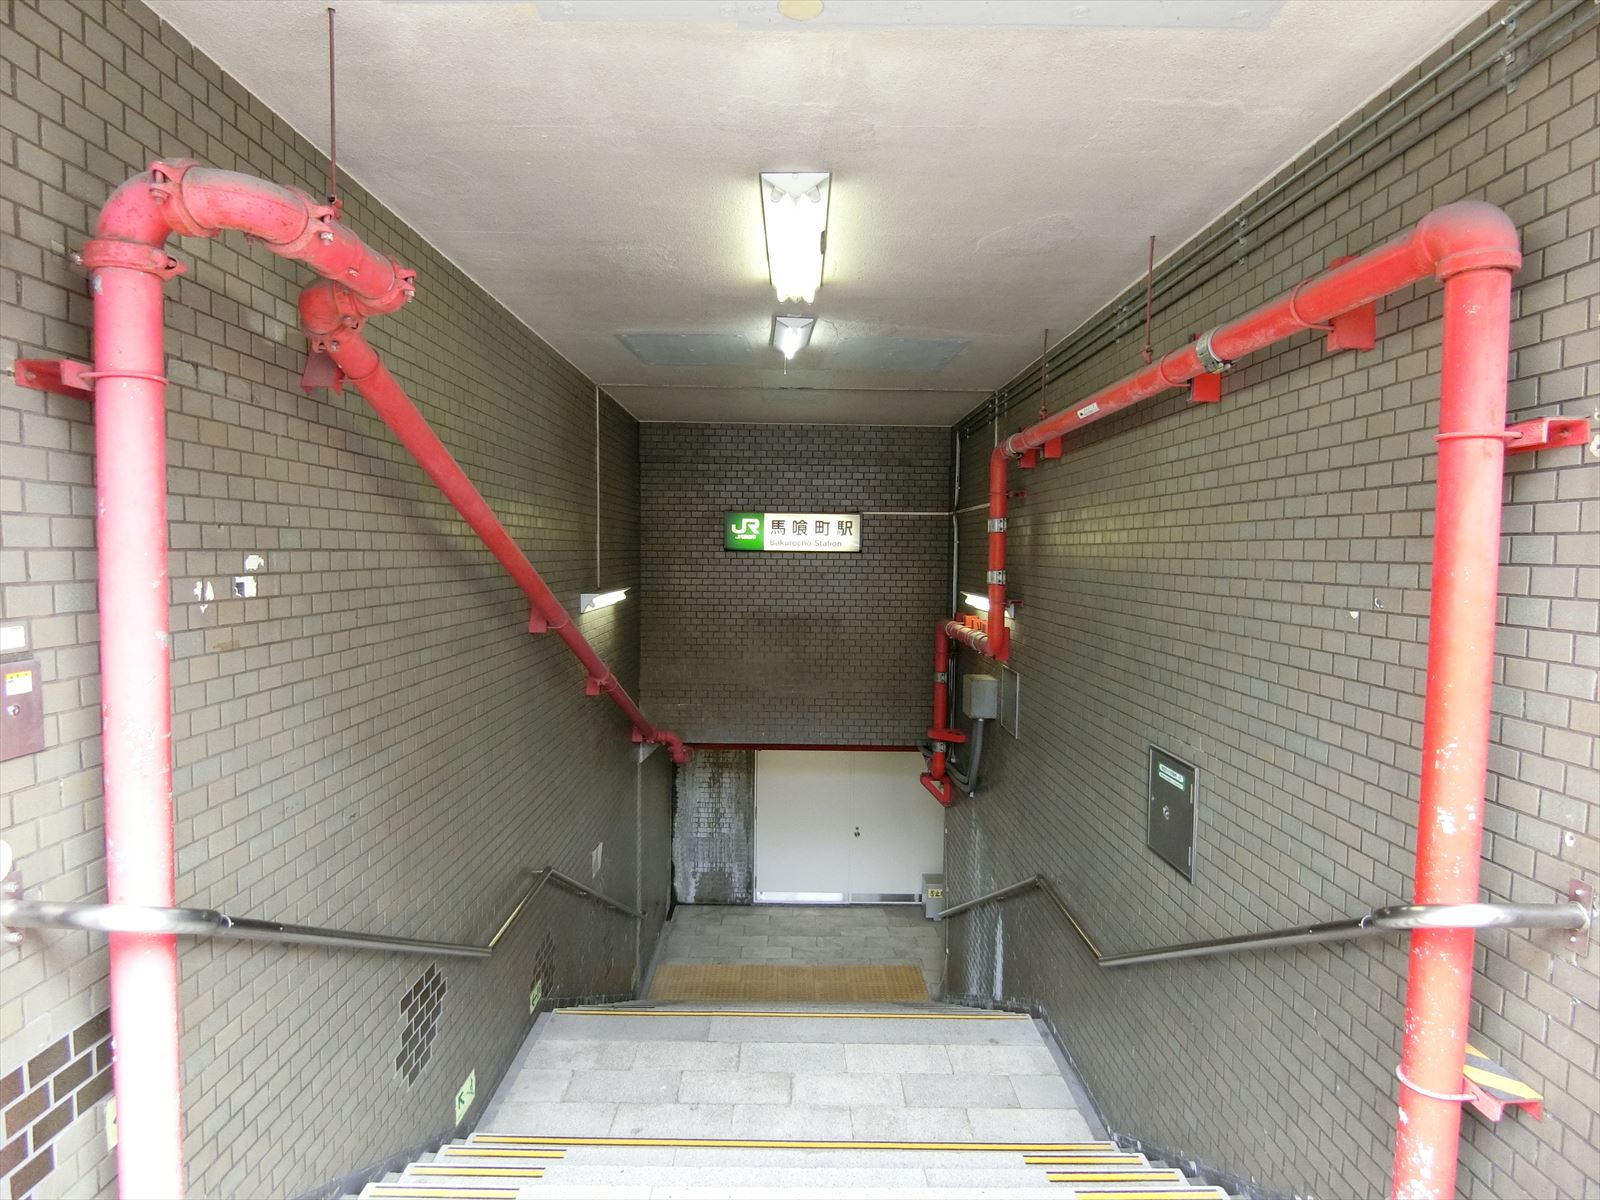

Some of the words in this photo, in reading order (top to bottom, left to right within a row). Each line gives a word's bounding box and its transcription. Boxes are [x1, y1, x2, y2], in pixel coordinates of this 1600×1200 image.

[731, 518, 760, 534] JR
[771, 520, 853, 536] 馬喰町駅
[814, 540, 843, 548] Station
